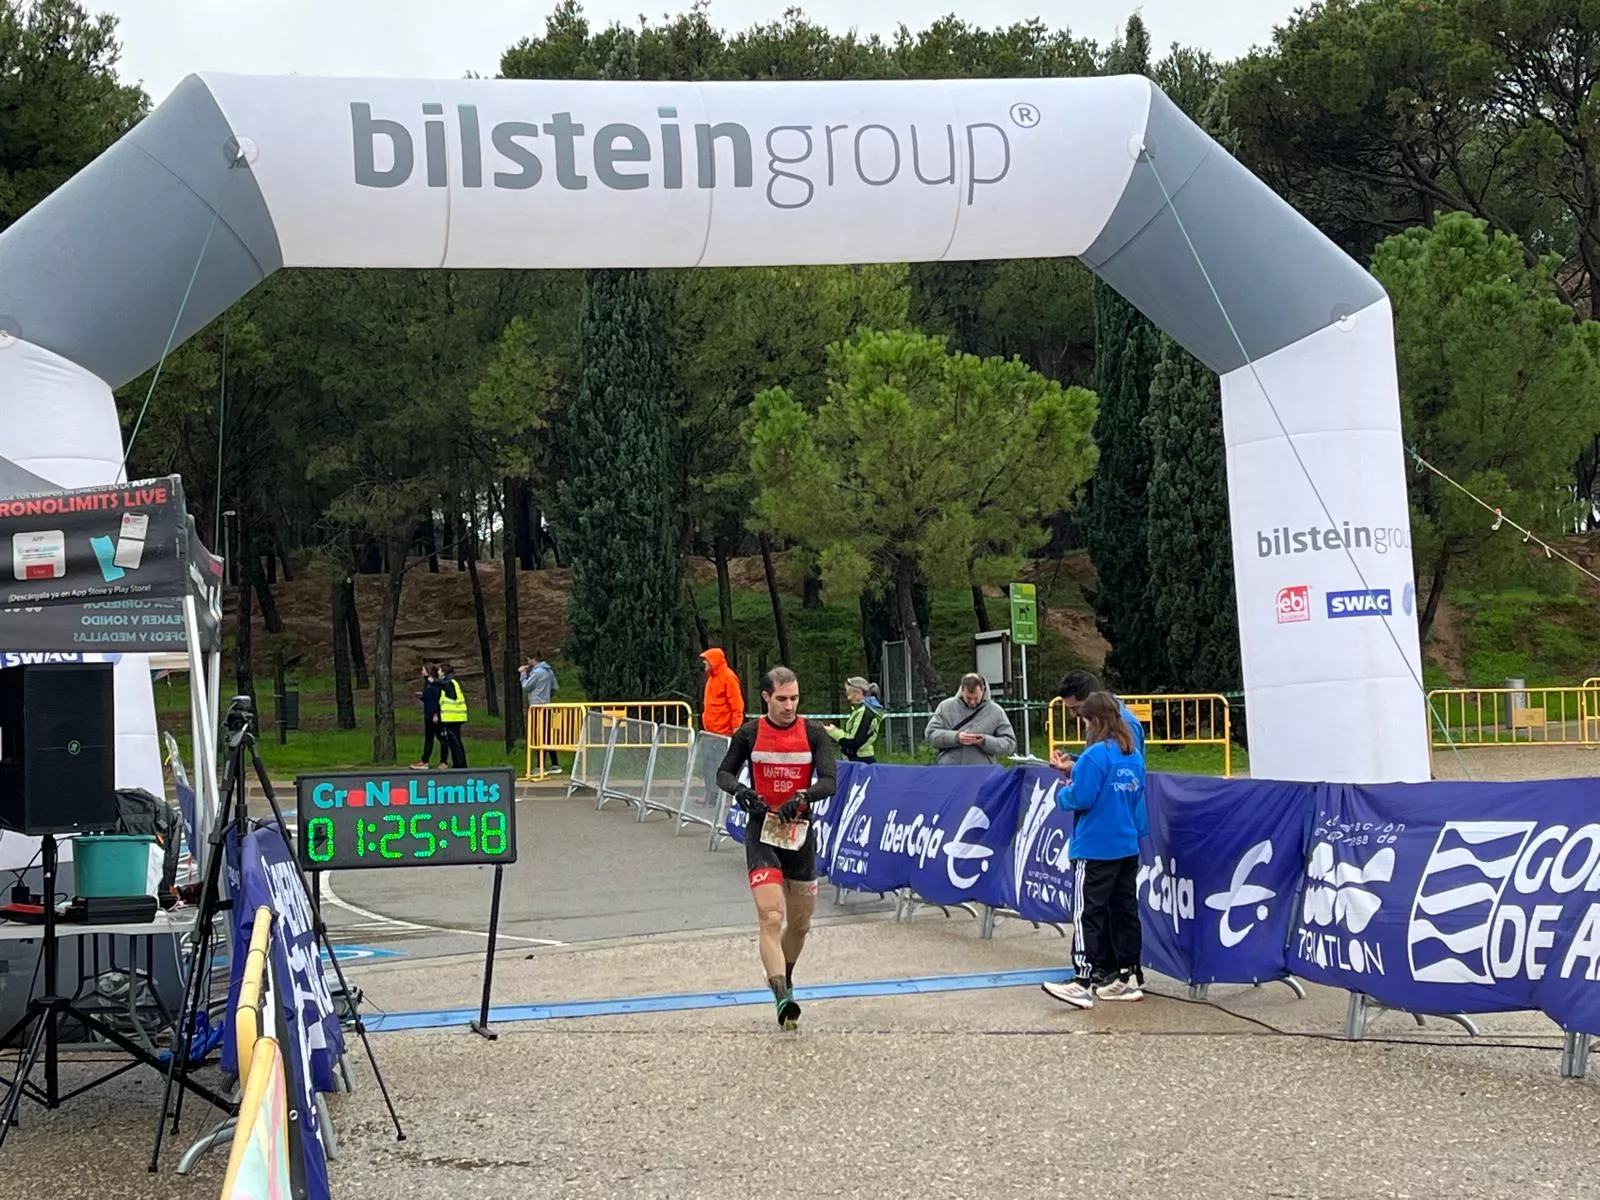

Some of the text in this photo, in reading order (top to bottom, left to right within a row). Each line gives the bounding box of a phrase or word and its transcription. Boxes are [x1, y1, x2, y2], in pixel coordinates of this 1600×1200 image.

[132, 478, 157, 488] APP
[0, 487, 167, 517] RONOLIMITS LIVE
[1257, 521, 1411, 557] bilsteingrou
[51, 591, 60, 601] ya
[71, 588, 87, 597] App
[88, 587, 107, 595] Store
[108, 586, 113, 594] y
[114, 585, 130, 594] Play
[1331, 594, 1389, 613] SWAG
[308, 810, 507, 862] 0 1:25:48
[847, 814, 872, 847] LIGA
[1376, 834, 1397, 844] de
[1036, 828, 1071, 873] LIGA
[1298, 928, 1385, 975] TRIATLON
[1490, 904, 1563, 980] DE
